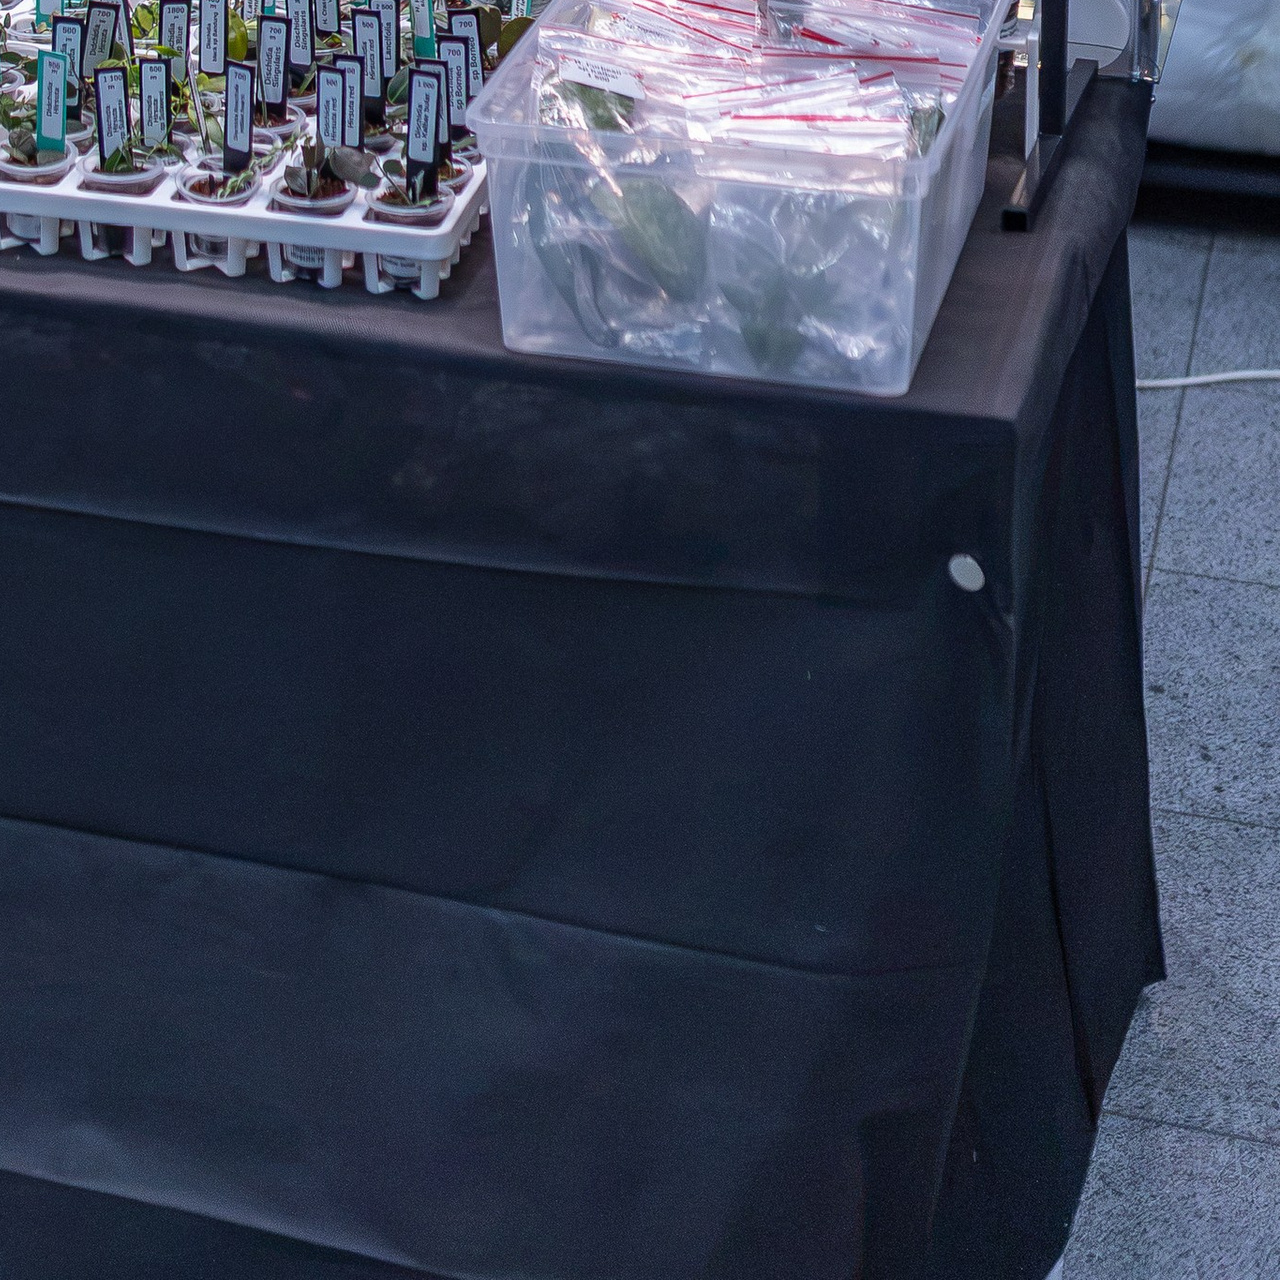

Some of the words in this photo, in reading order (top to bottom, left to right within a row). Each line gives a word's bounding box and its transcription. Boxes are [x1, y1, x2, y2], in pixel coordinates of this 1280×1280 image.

[301, 11, 309, 50] Singularis
[384, 22, 392, 61] Lancifolia
[264, 47, 273, 86] Dischidia
[272, 47, 282, 88] Singularis
[470, 37, 478, 68] Borneo
[455, 66, 463, 98] Borneo
